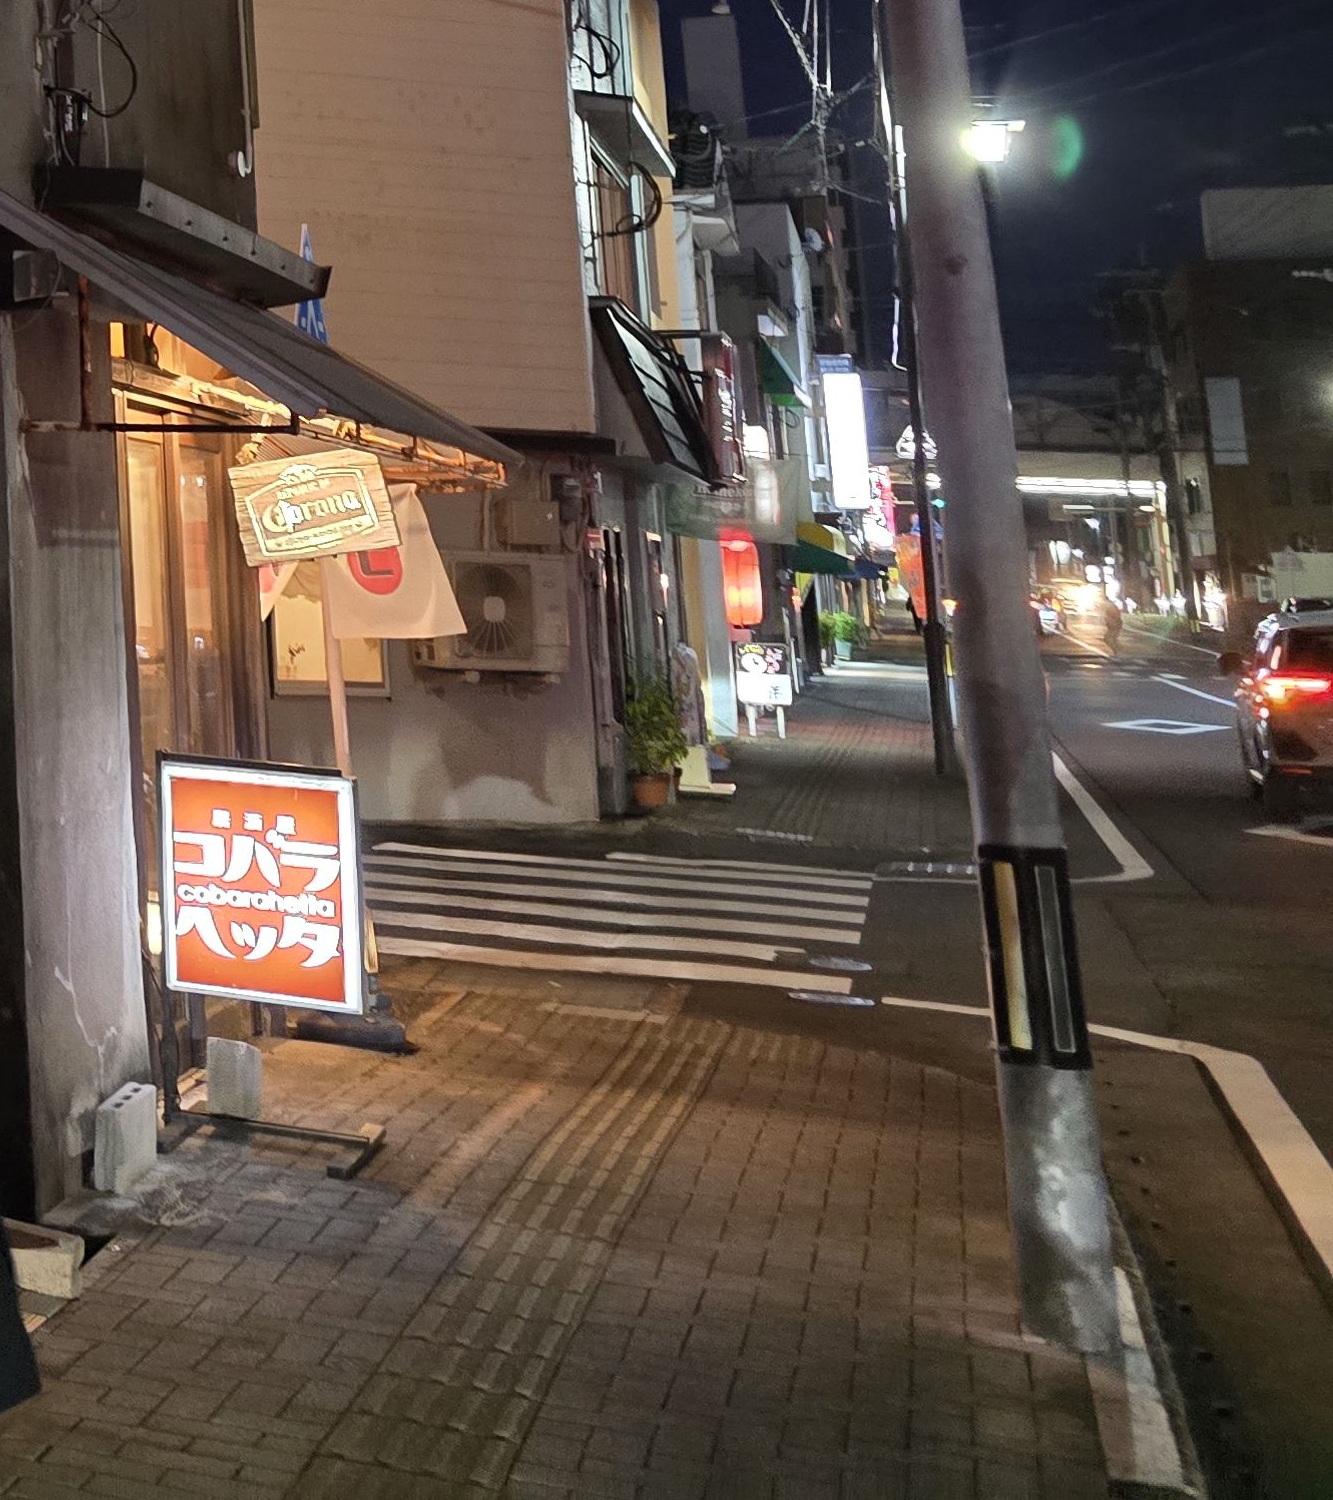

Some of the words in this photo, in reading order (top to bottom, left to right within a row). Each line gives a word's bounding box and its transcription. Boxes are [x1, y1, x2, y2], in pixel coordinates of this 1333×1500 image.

[261, 490, 362, 533] Corona
[176, 905, 341, 968] ヘッタ
